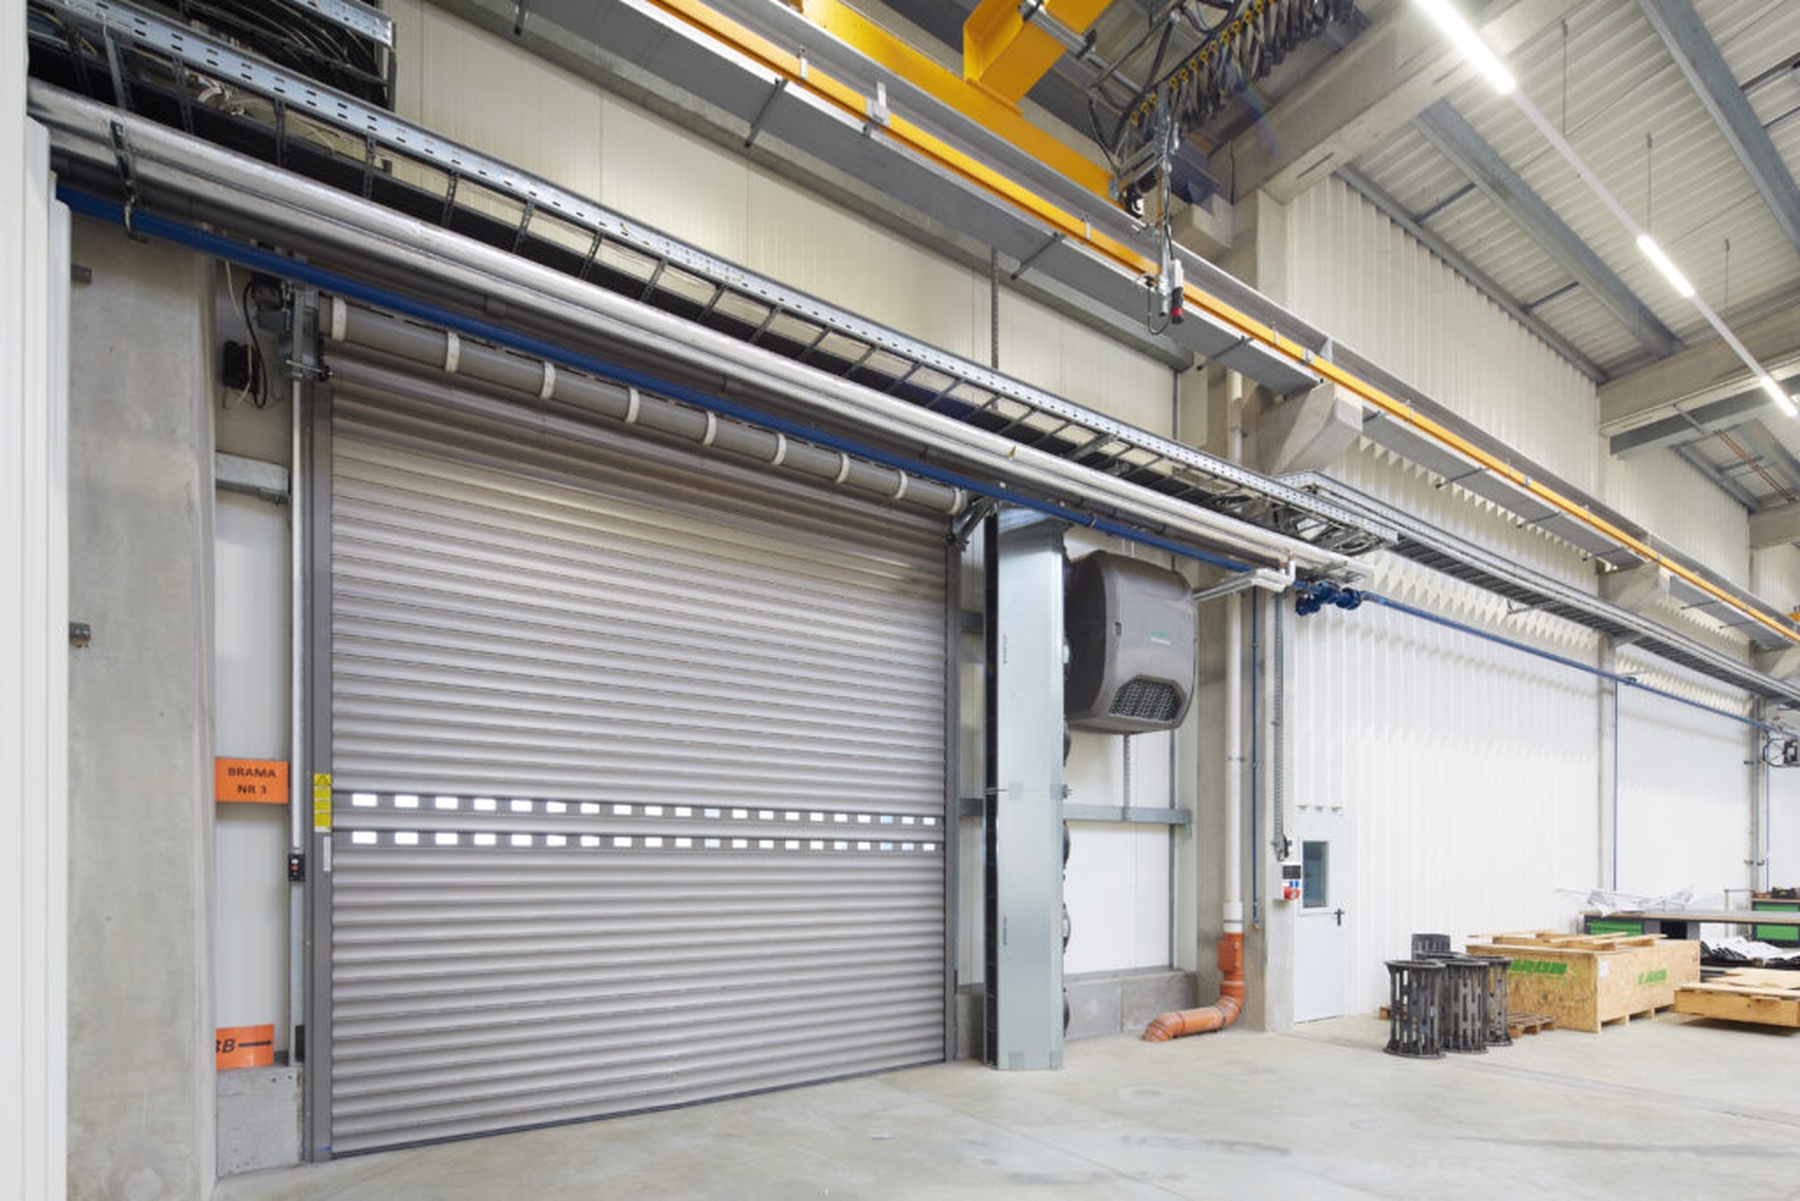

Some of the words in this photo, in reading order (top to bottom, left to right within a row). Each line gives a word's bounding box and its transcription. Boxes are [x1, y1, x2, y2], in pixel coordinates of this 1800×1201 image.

[228, 767, 276, 777] BRAMA
[238, 785, 256, 794] NR
[260, 785, 267, 794] 3
